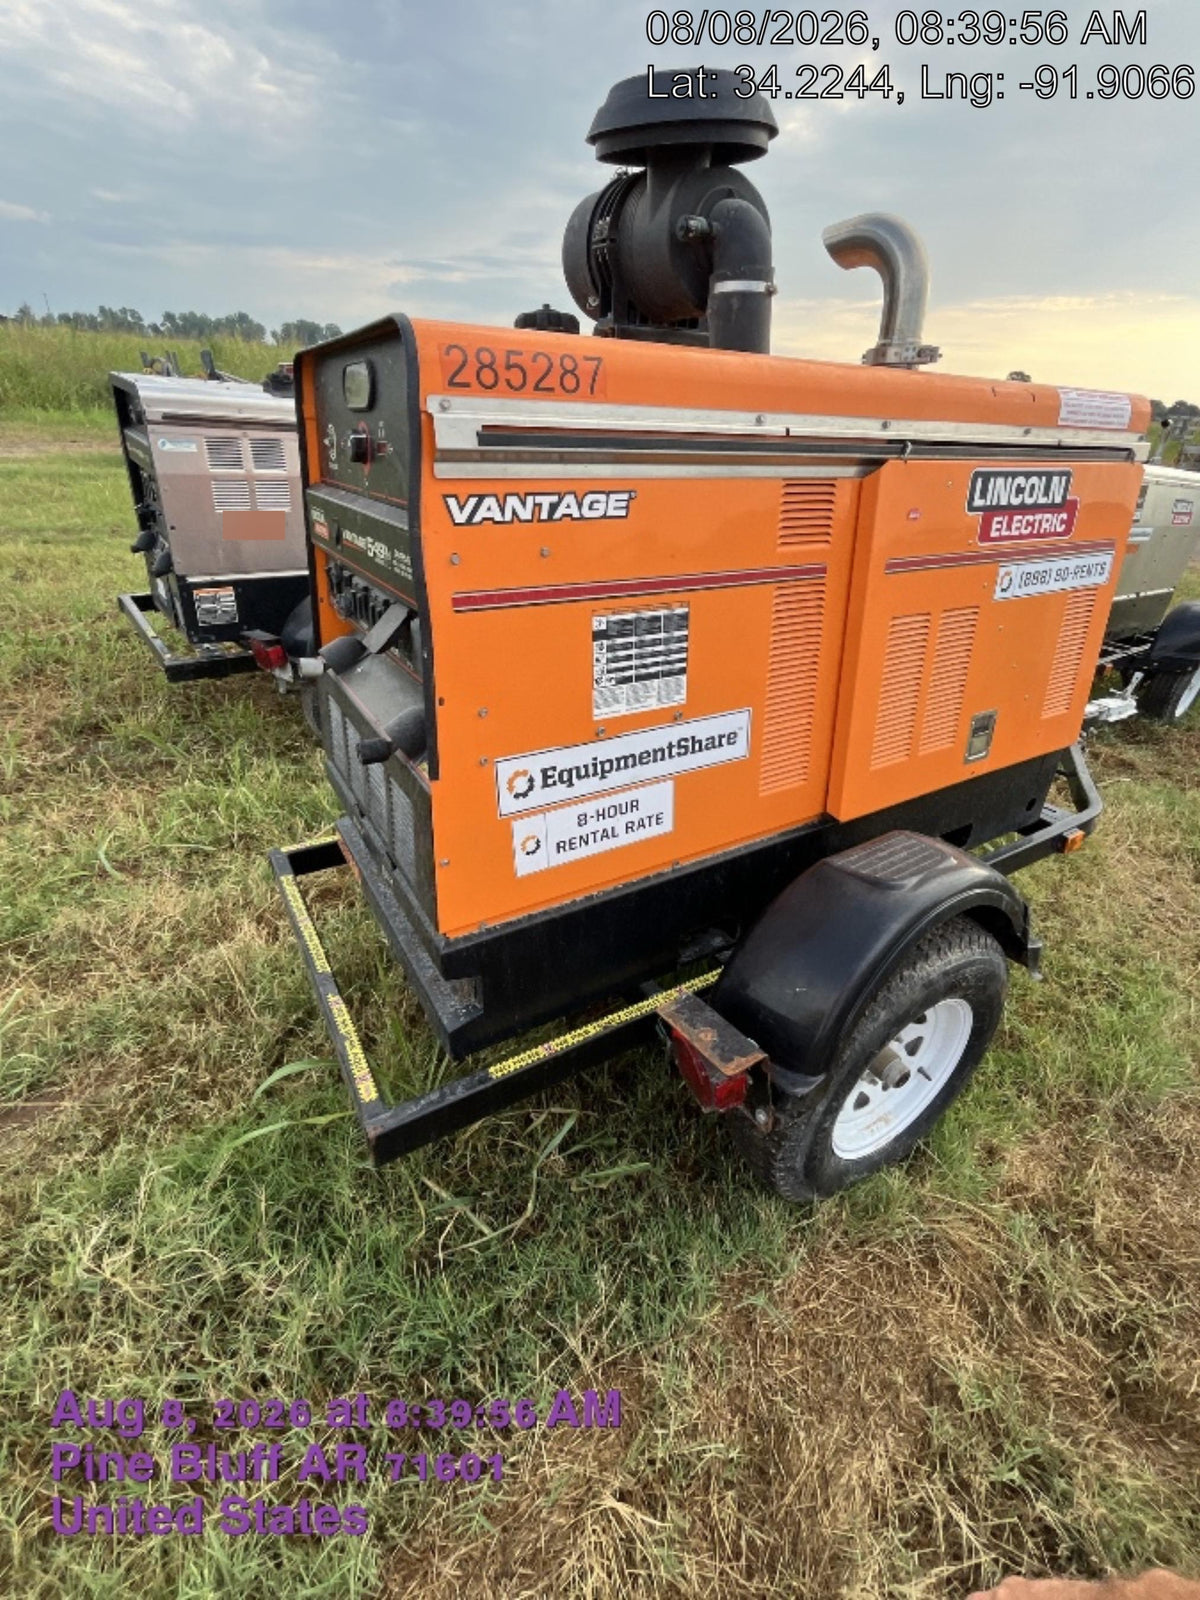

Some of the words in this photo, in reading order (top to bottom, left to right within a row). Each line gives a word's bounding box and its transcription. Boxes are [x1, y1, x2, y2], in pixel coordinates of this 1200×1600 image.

[443, 344, 604, 396] 285287
[443, 491, 636, 526] VANTAGE
[972, 475, 1068, 507] LINCOLN
[989, 512, 1068, 538] ELECTRIC
[540, 729, 739, 789] EquipmentShare
[576, 799, 640, 828] 8-HOUR
[556, 826, 619, 854] RENTAL
[625, 812, 665, 835] RATE
